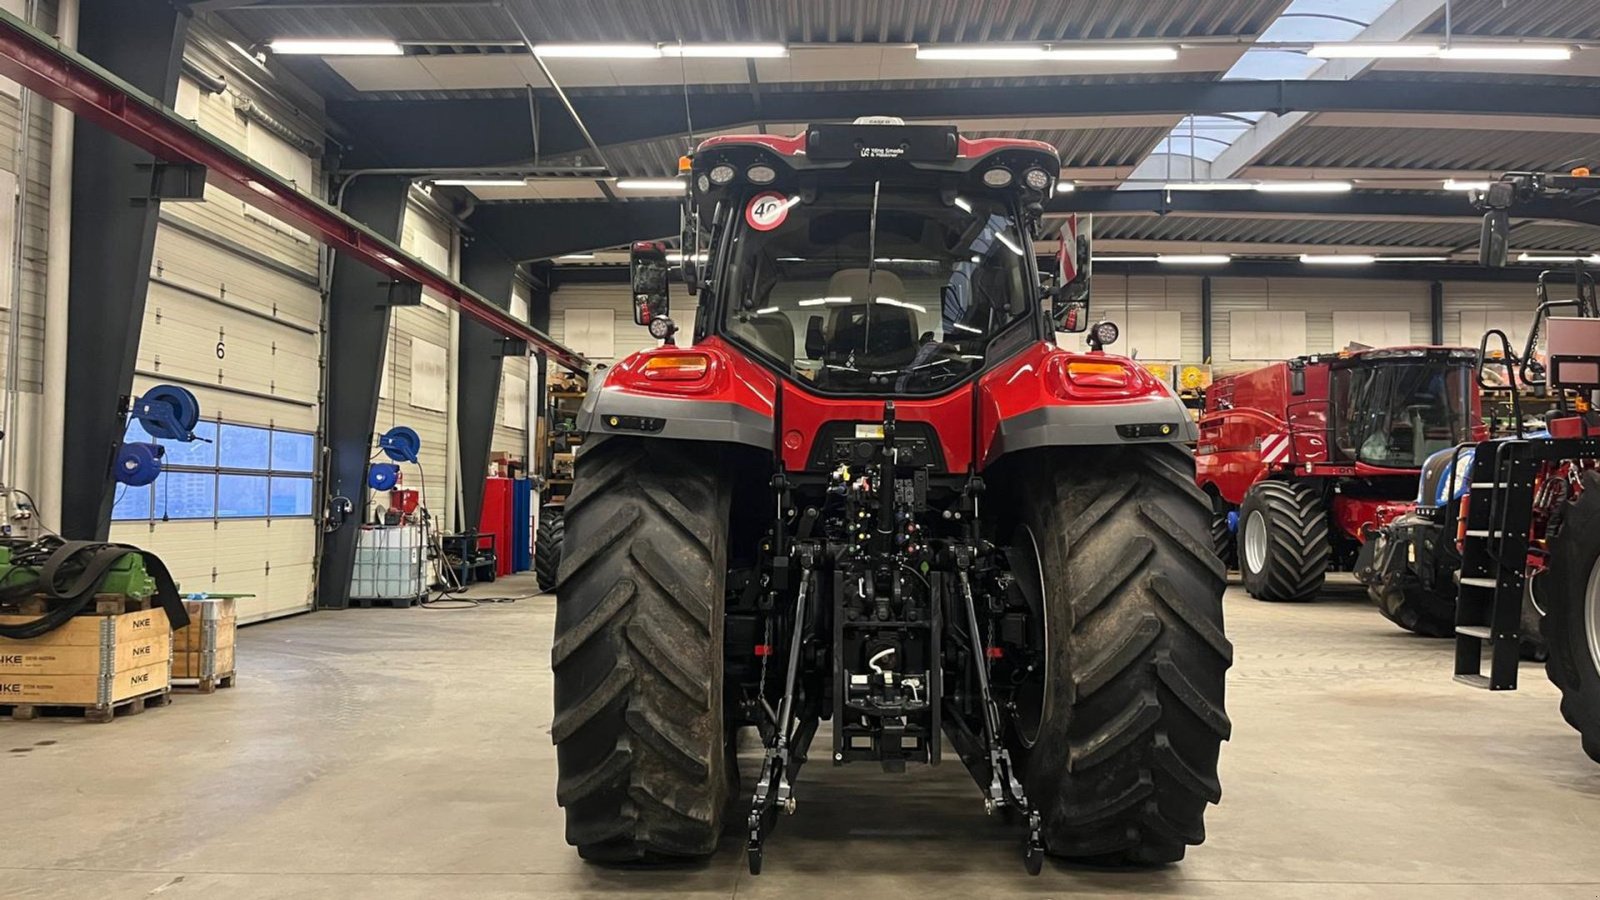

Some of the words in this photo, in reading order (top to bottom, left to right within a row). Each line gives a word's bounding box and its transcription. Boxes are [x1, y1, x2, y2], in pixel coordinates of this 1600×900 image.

[216, 342, 225, 359] 6
[132, 618, 151, 628] NKE
[132, 645, 151, 656] NKE
[130, 673, 149, 684] NKE
[0, 683, 21, 692] KE
